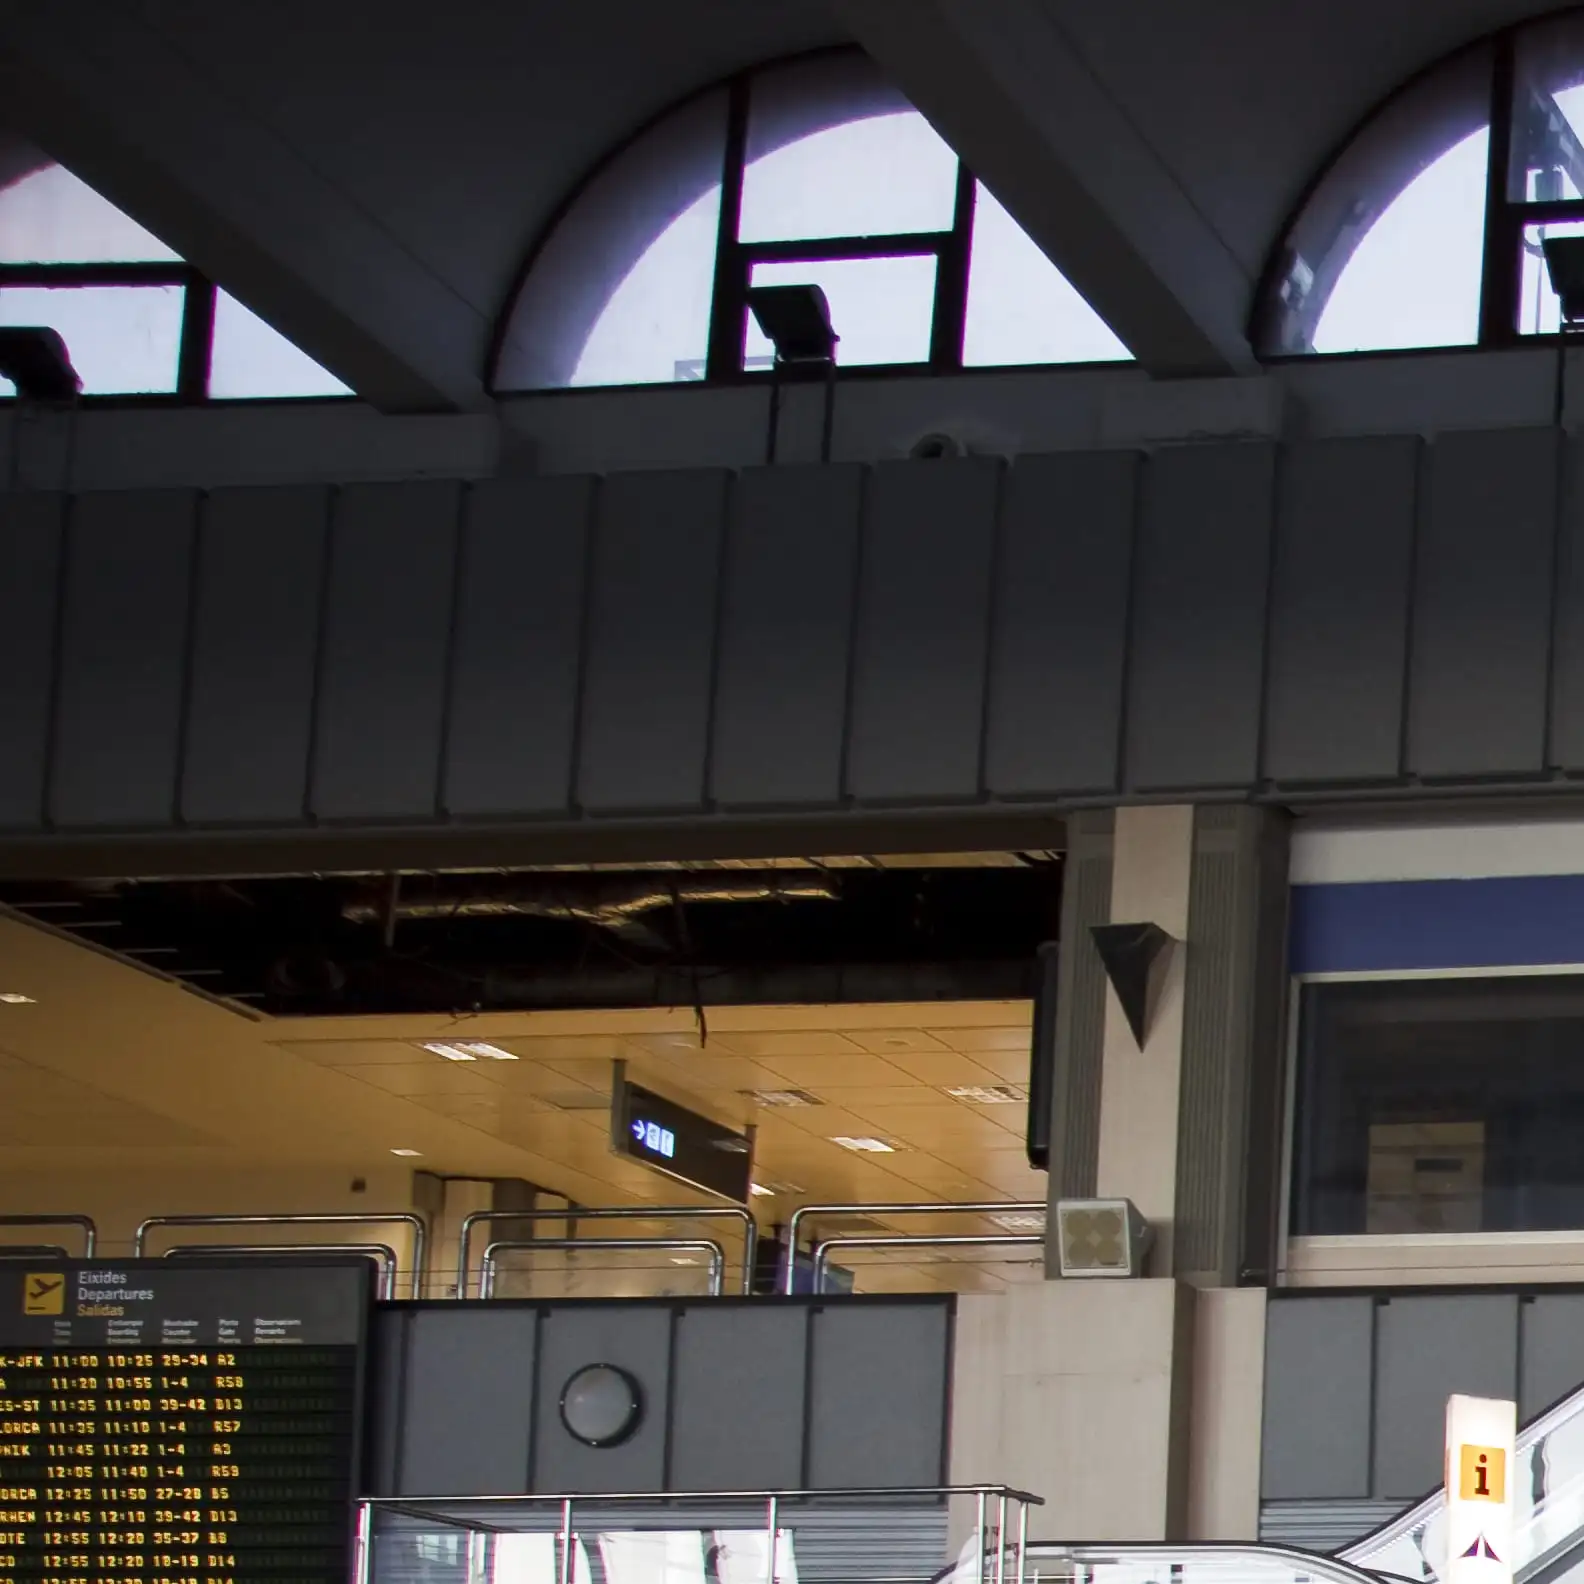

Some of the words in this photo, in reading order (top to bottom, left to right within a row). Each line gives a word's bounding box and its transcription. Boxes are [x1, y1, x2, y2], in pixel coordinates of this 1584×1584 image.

[78, 1271, 127, 1284] Eixides
[78, 1287, 154, 1301] Departures
[77, 1304, 125, 1317] Salidas
[52, 1355, 99, 1368] 11:00
[107, 1354, 153, 1367] 10:25
[161, 1353, 208, 1367] 29-34
[51, 1377, 97, 1390] 11:20
[161, 1376, 189, 1389] 1-4
[50, 1399, 96, 1412] 11:35
[105, 1398, 152, 1412] 11:00
[159, 1398, 207, 1411] 39-42
[49, 1421, 95, 1434] 11:35
[104, 1421, 150, 1434] 11:10
[159, 1421, 186, 1433] 1-4
[213, 1420, 241, 1433] R57
[49, 1444, 94, 1457] 11:45
[103, 1443, 149, 1456] 11:22
[158, 1443, 185, 1456] 1-4
[47, 1465, 93, 1479] 12:05
[102, 1465, 148, 1478] 11:40
[157, 1465, 185, 1478] 1-4
[46, 1487, 92, 1501] 12:25
[101, 1487, 147, 1501] 11:50
[45, 1510, 91, 1523] 12:45
[99, 1510, 146, 1523] 12:10
[155, 1510, 201, 1523] 39-42
[43, 1532, 90, 1545] 12:55
[99, 1532, 145, 1545] 12:20
[153, 1531, 200, 1545] 35-37
[43, 1555, 89, 1568] 12:55
[98, 1555, 144, 1568] 12:20
